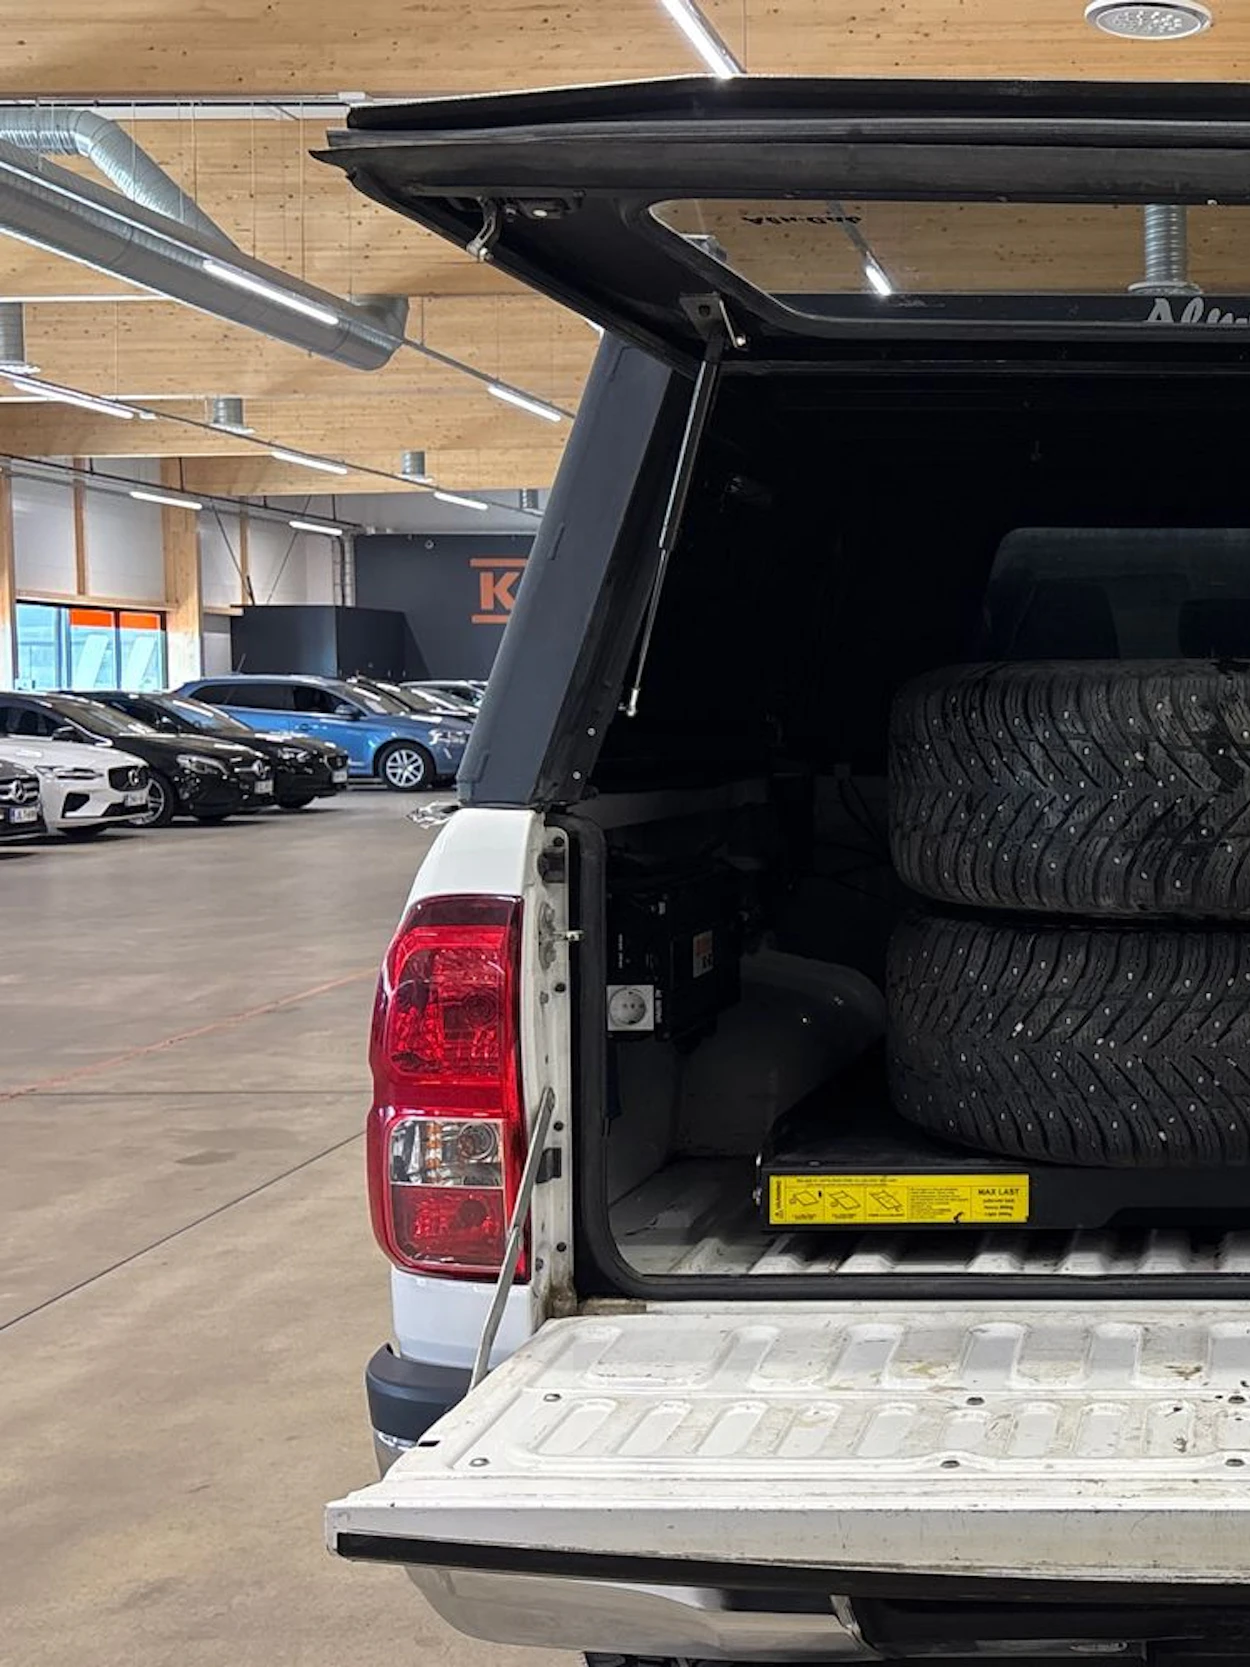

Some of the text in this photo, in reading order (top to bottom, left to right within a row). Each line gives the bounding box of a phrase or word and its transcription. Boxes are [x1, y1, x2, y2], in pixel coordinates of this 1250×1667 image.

[480, 571, 520, 611] K
[978, 1188, 1020, 1196] MAX LAST
